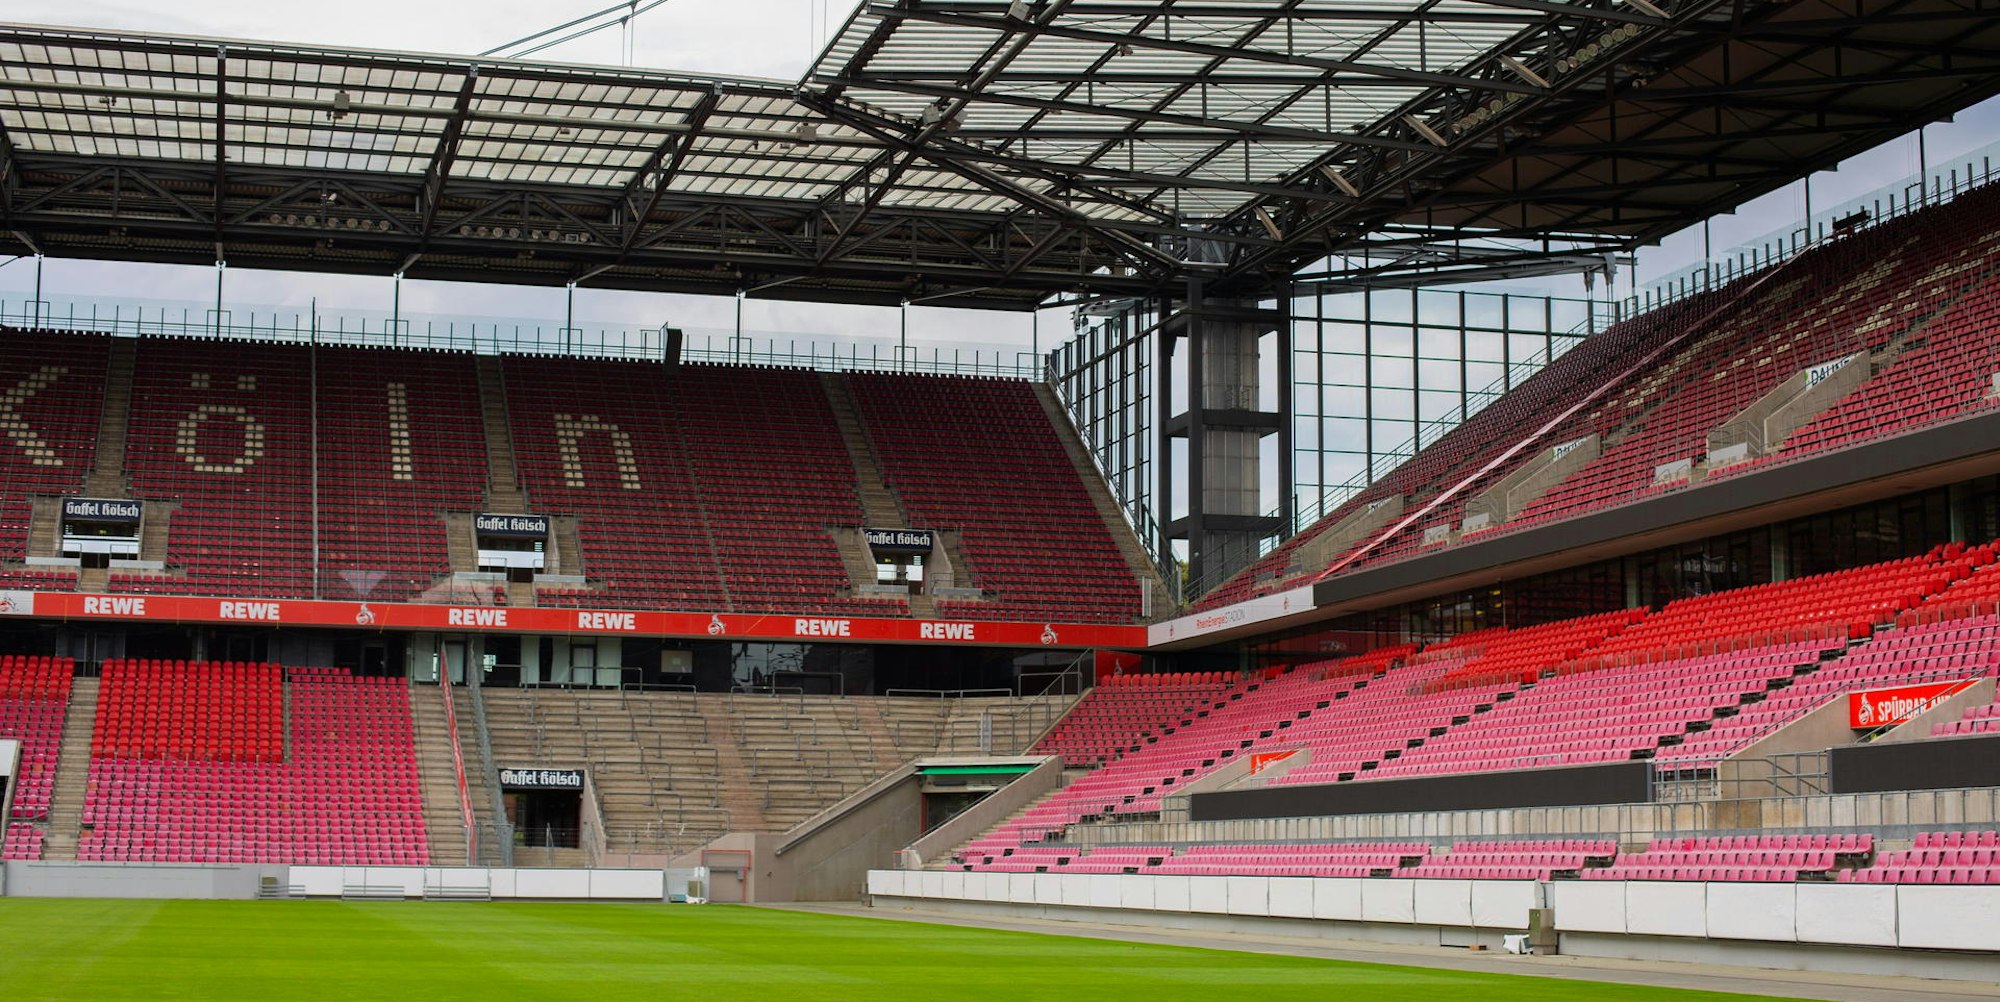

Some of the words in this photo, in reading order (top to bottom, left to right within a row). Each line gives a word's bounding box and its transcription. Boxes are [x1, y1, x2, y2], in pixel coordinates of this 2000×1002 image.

[66, 502, 99, 516] Gaffel
[102, 502, 139, 518] Kölsch
[477, 517, 509, 531] Gaffel
[511, 518, 546, 533] Kölsch
[897, 532, 931, 546] Kölsch
[84, 597, 145, 615] REWE
[220, 601, 280, 620] REWE
[448, 608, 507, 627] REWE
[578, 612, 635, 630] REWE
[795, 619, 850, 636] REWE
[920, 622, 975, 640] REWE
[1878, 696, 1928, 722] SPÜRBAR
[500, 770, 538, 785] Gaffel
[540, 770, 580, 786] Kölsch
